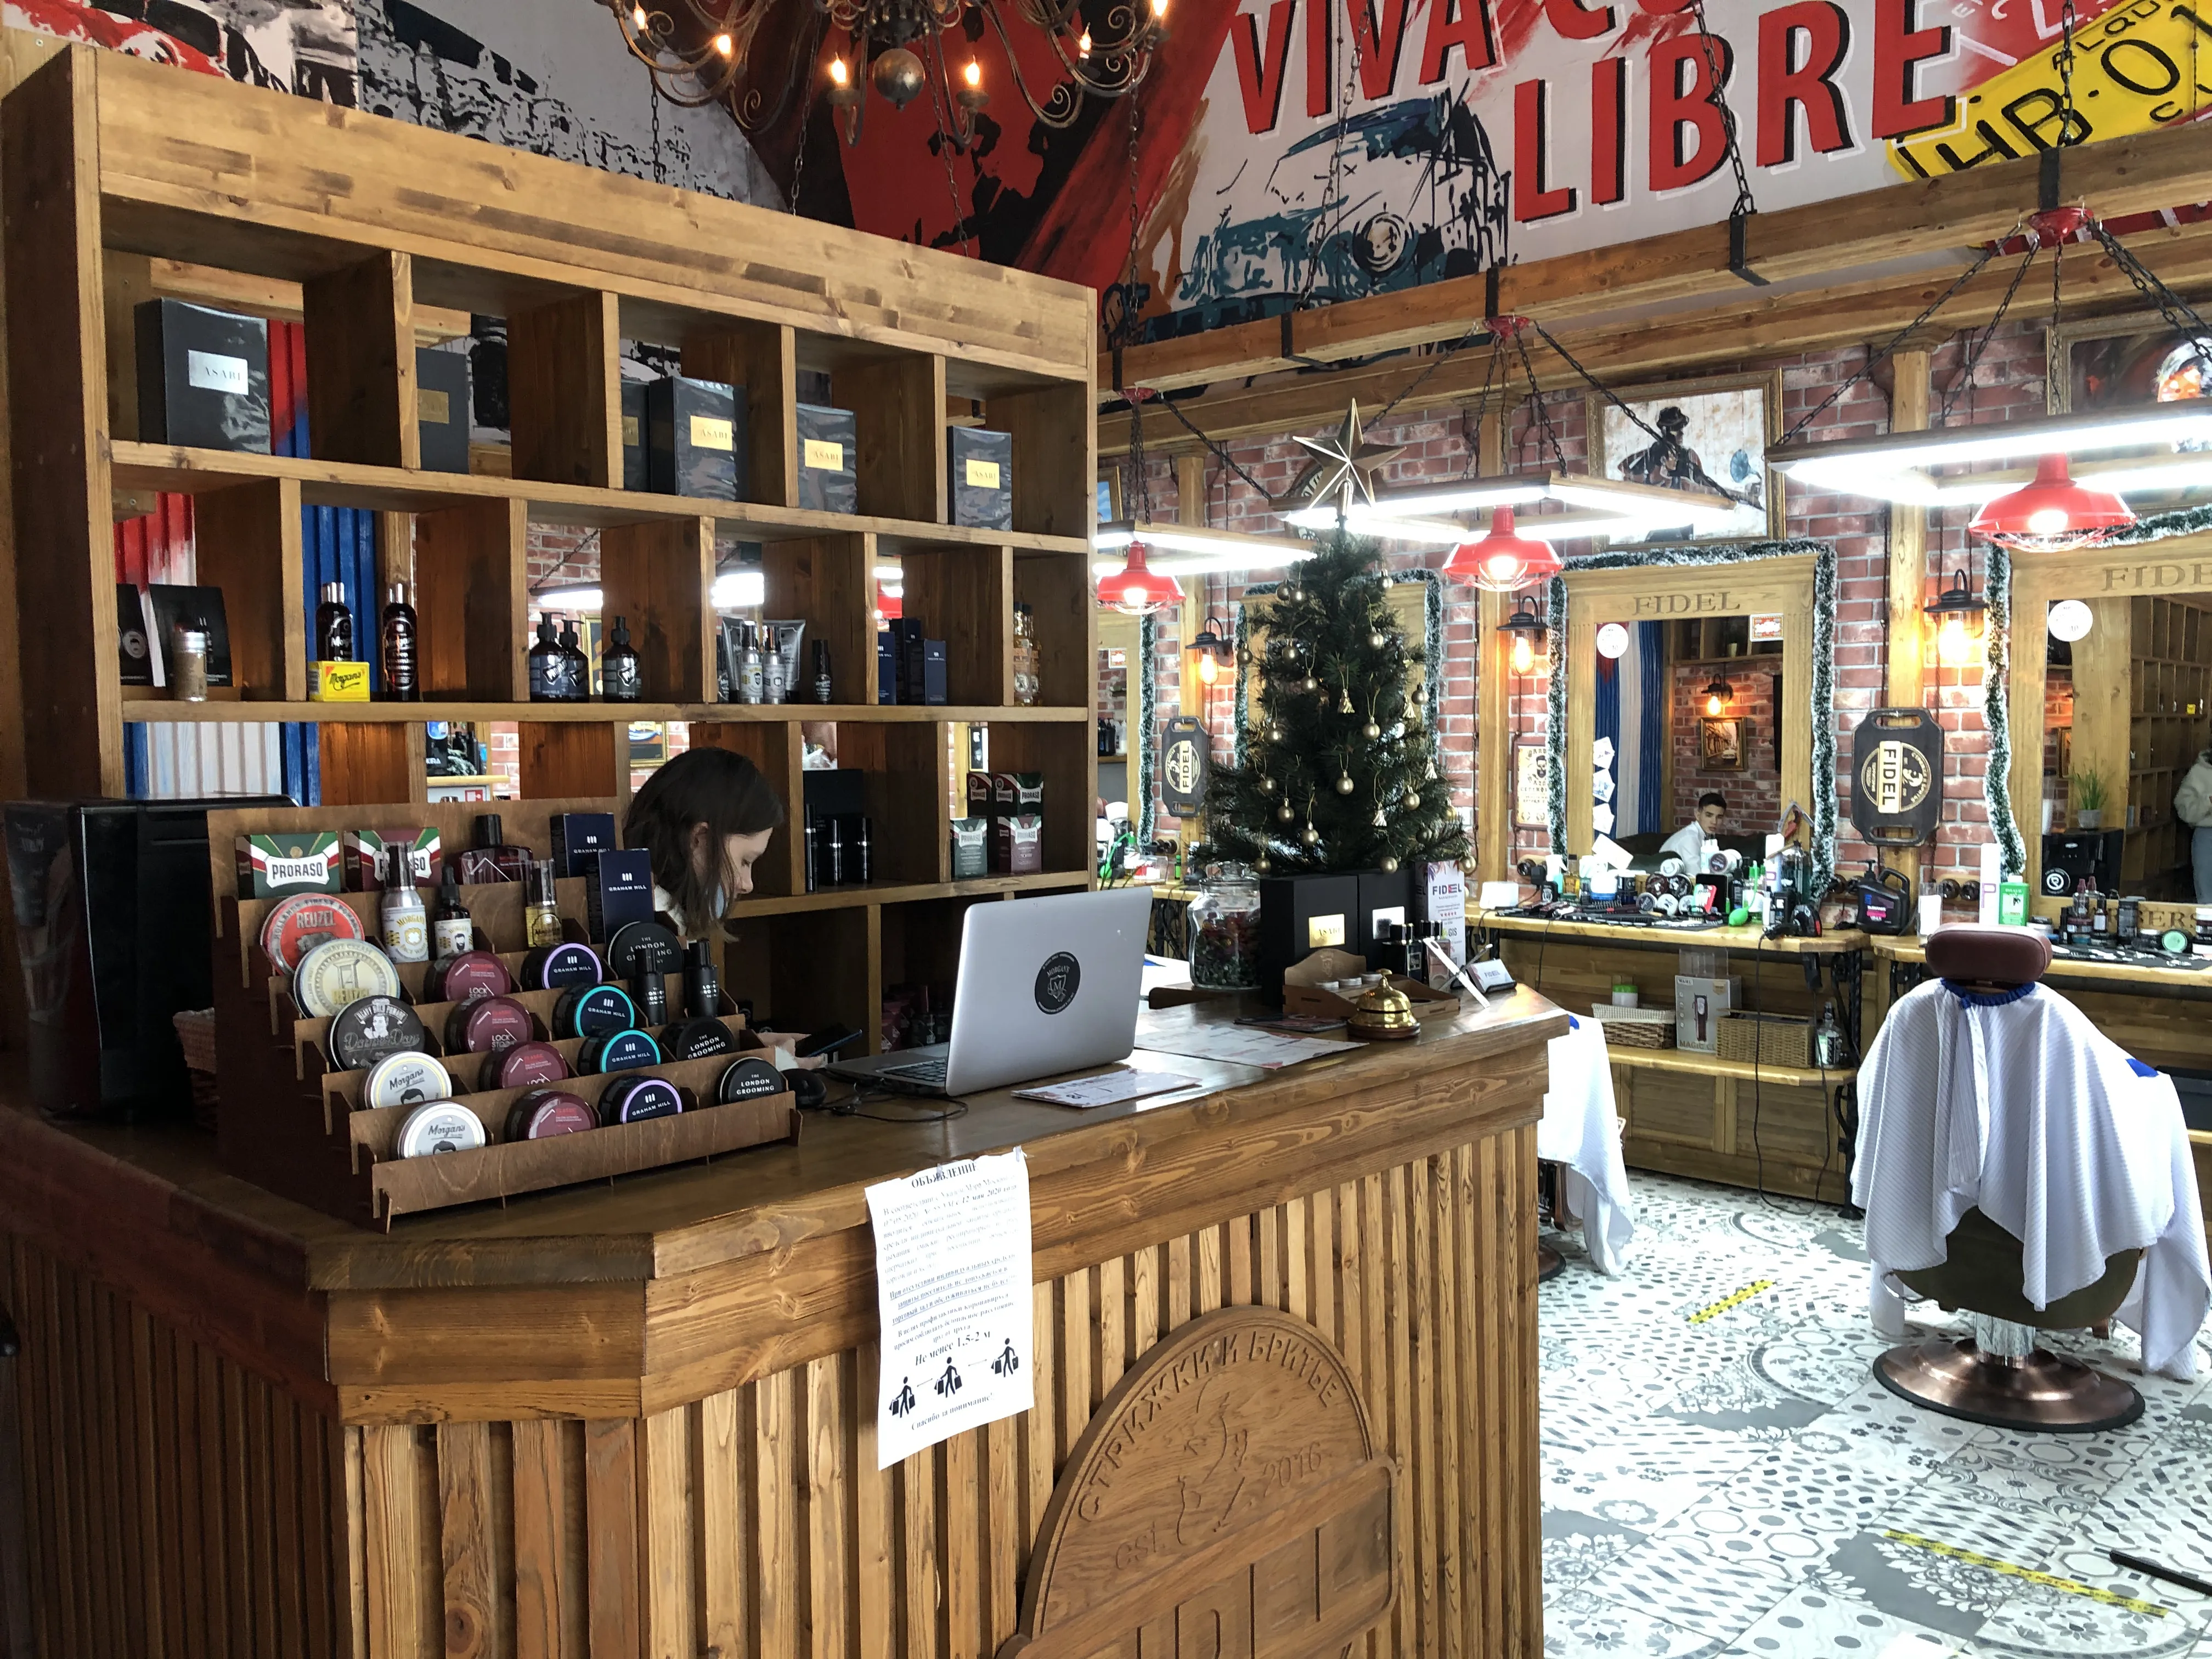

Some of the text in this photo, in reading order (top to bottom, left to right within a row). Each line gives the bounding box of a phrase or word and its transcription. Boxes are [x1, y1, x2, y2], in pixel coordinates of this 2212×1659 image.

[1229, 0, 1499, 135] VIVA
[1513, 0, 1963, 225] LIBRE
[205, 366, 241, 381] ASABI
[701, 428, 728, 439] ASABI
[814, 450, 839, 461] ASABI
[974, 470, 996, 481] ASABI
[2101, 563, 2212, 591] FIDE
[1631, 591, 1740, 616] FIDEL
[1882, 748, 1897, 806] FIDEL
[1022, 791, 1040, 800] PRORASO
[272, 861, 323, 880] PRORASO
[1431, 883, 1463, 896] FIDEL
[296, 910, 336, 929] REUZEL
[1318, 927, 1341, 938] ASABI
[626, 948, 673, 962] GING
[630, 941, 665, 952] LONDON
[1483, 970, 1501, 978] FIDEL
[687, 1041, 726, 1059] GROOMING
[690, 1036, 720, 1052] LONDON
[1679, 1040, 1705, 1049] MAGIC
[389, 1068, 425, 1091] Morgan's
[741, 1078, 770, 1087] LONDON
[736, 1085, 775, 1096] GROOMING
[631, 1100, 672, 1116] GRAHAM HILL
[427, 1124, 466, 1138] Morgan's
[911, 1162, 978, 1189] ОБЪЯВЛЕНИЕ
[962, 1195, 970, 1204] 12
[986, 1187, 1002, 1198] 2020
[890, 1289, 902, 1300] При
[902, 1277, 935, 1295] отсутствии
[936, 1261, 990, 1282] индивидуальных
[898, 1295, 919, 1310] защиты
[920, 1282, 953, 1300] посетитель
[964, 1268, 1003, 1284] допускается
[892, 1308, 918, 1325] торговый
[919, 1304, 929, 1313] зал
[934, 1286, 983, 1306] обслуживаться
[903, 1323, 919, 1336] целях
[919, 1307, 963, 1329] профилактики
[964, 1293, 1009, 1311] коронавируса
[894, 1302, 1015, 1352] просим соблюдать безопасное расстояние
[933, 1333, 944, 1344] друг
[953, 1324, 971, 1335] друга
[915, 1352, 928, 1366] Не
[929, 1342, 954, 1358] менее
[983, 1330, 991, 1339] м
[911, 1412, 940, 1431] Спасибо
[950, 1392, 994, 1414] понимание!
[1077, 1344, 1211, 1523] СТРИЖКИ
[1248, 1330, 1339, 1408] БРИТЬЕ
